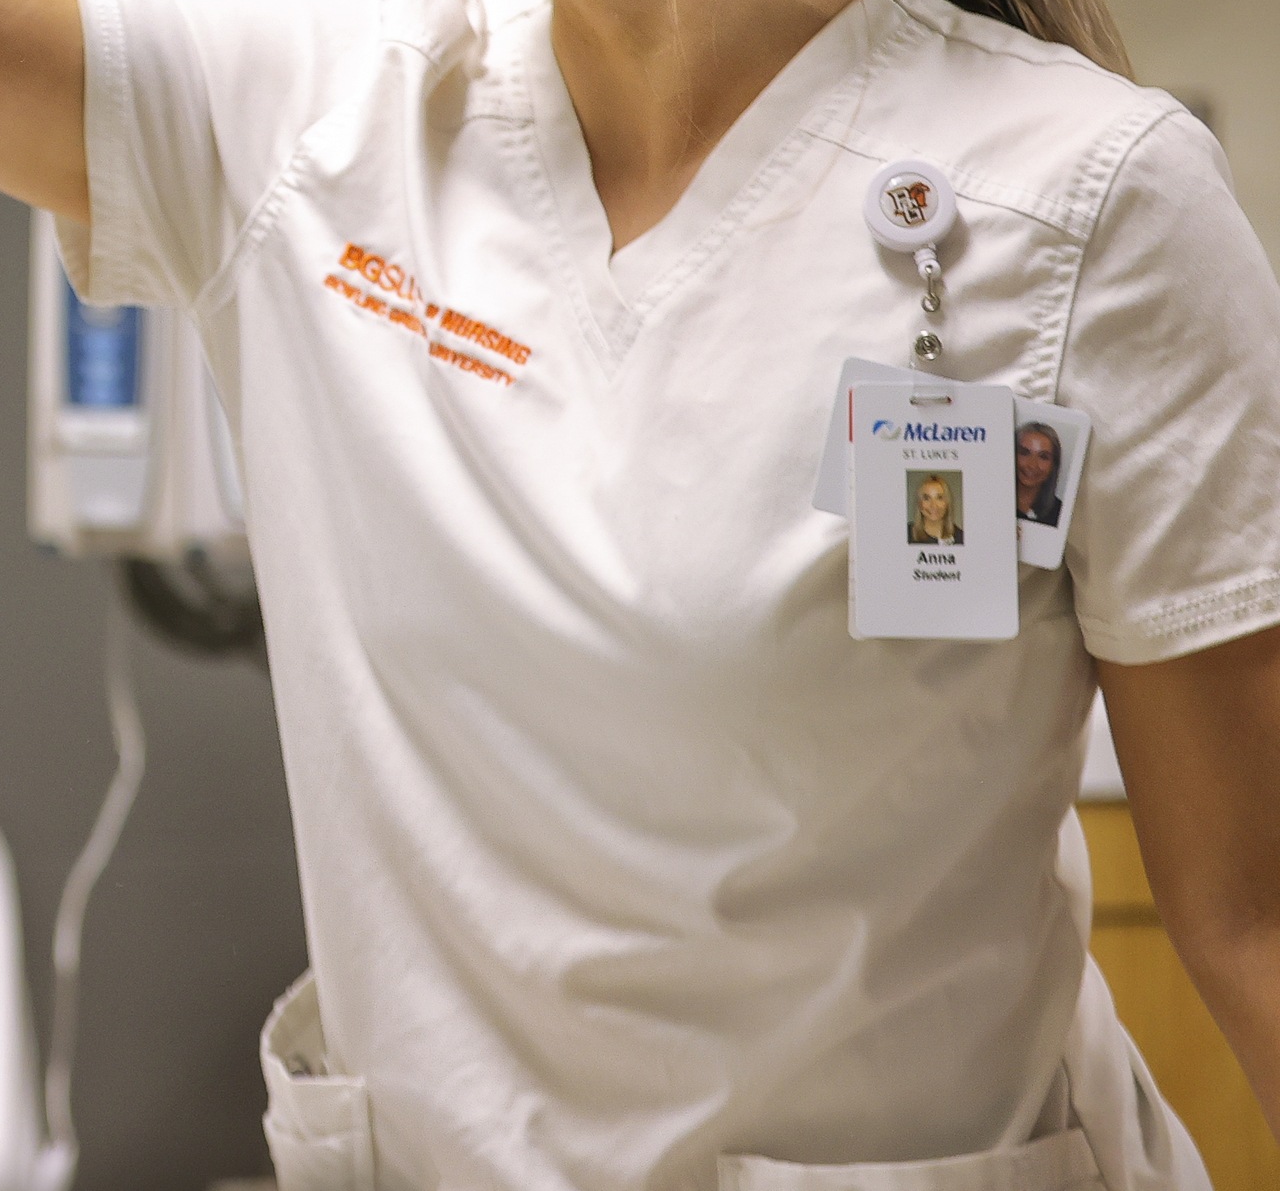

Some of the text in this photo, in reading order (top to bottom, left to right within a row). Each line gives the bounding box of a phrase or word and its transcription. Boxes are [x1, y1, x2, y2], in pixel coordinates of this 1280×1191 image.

[441, 308, 532, 365] NURSING
[904, 422, 986, 442] McLaren
[917, 551, 956, 565] Anna
[912, 569, 961, 581] Student
